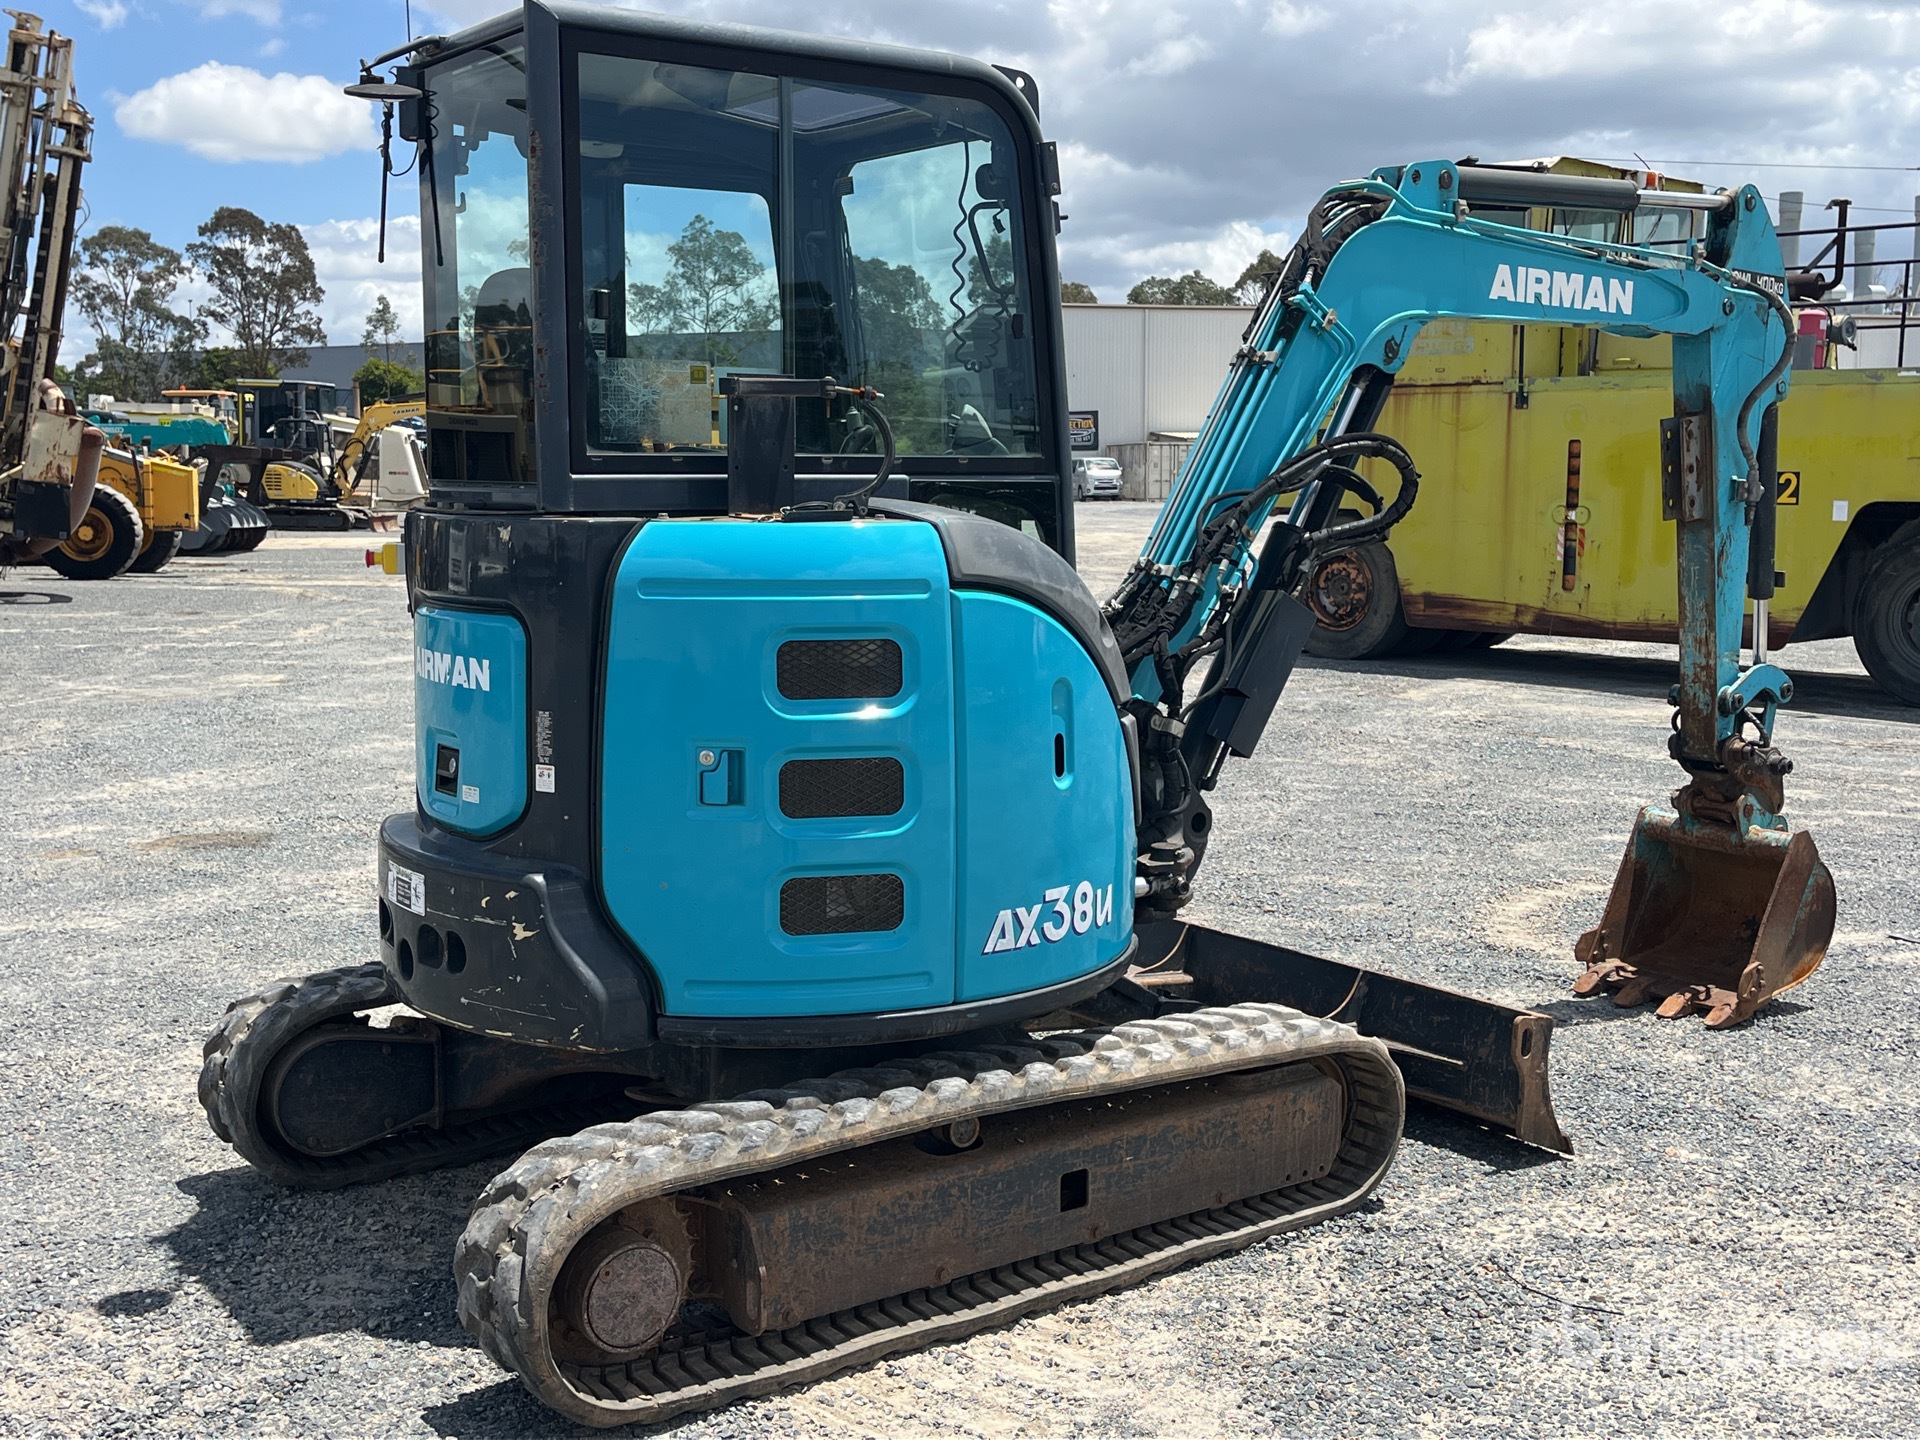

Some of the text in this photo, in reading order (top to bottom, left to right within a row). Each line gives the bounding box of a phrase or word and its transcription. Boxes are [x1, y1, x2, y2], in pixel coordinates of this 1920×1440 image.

[1489, 263, 1634, 315] AIRMAN
[393, 407, 420, 415] YANMAR
[1776, 472, 1798, 504] 2
[416, 645, 490, 692] AIRMAN
